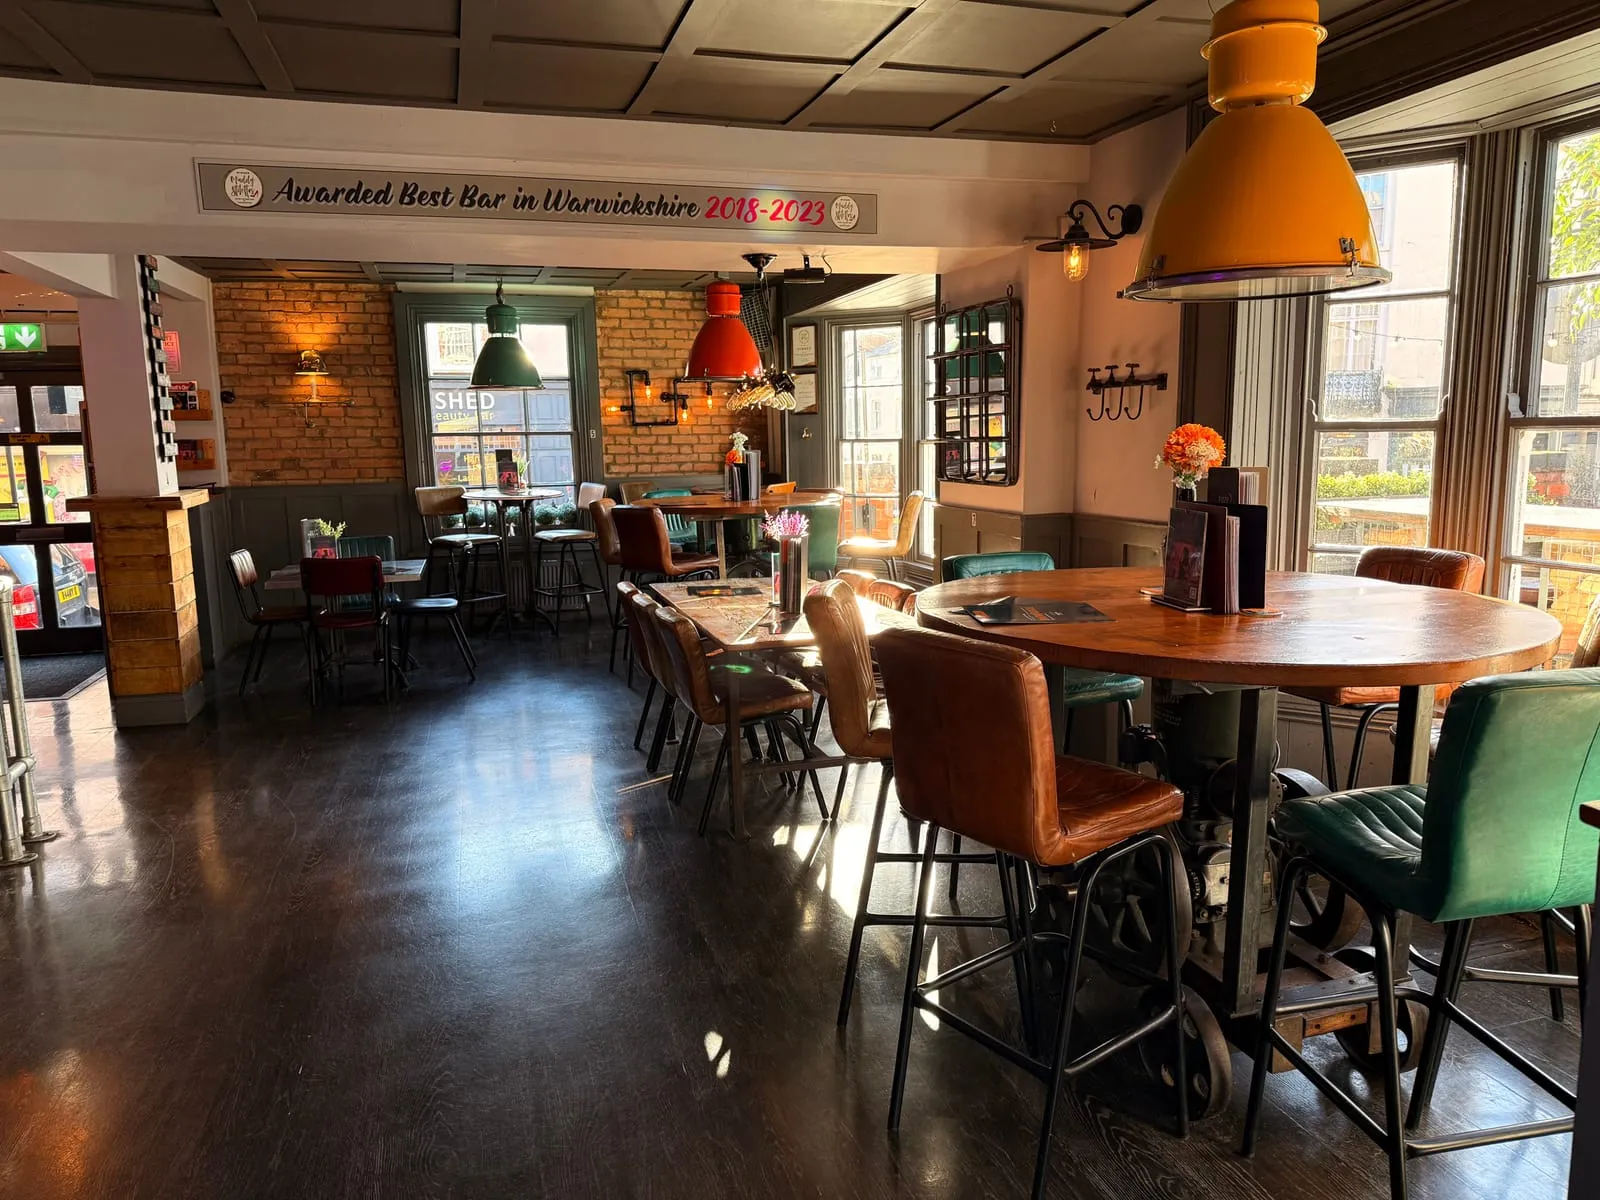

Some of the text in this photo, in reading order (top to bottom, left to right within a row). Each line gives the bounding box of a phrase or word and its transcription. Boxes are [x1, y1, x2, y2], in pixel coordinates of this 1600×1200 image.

[274, 177, 825, 225] Awarded Best Bar in Warwickshire 2018-2023
[435, 391, 495, 410] SHED
[435, 412, 470, 421] eauty
